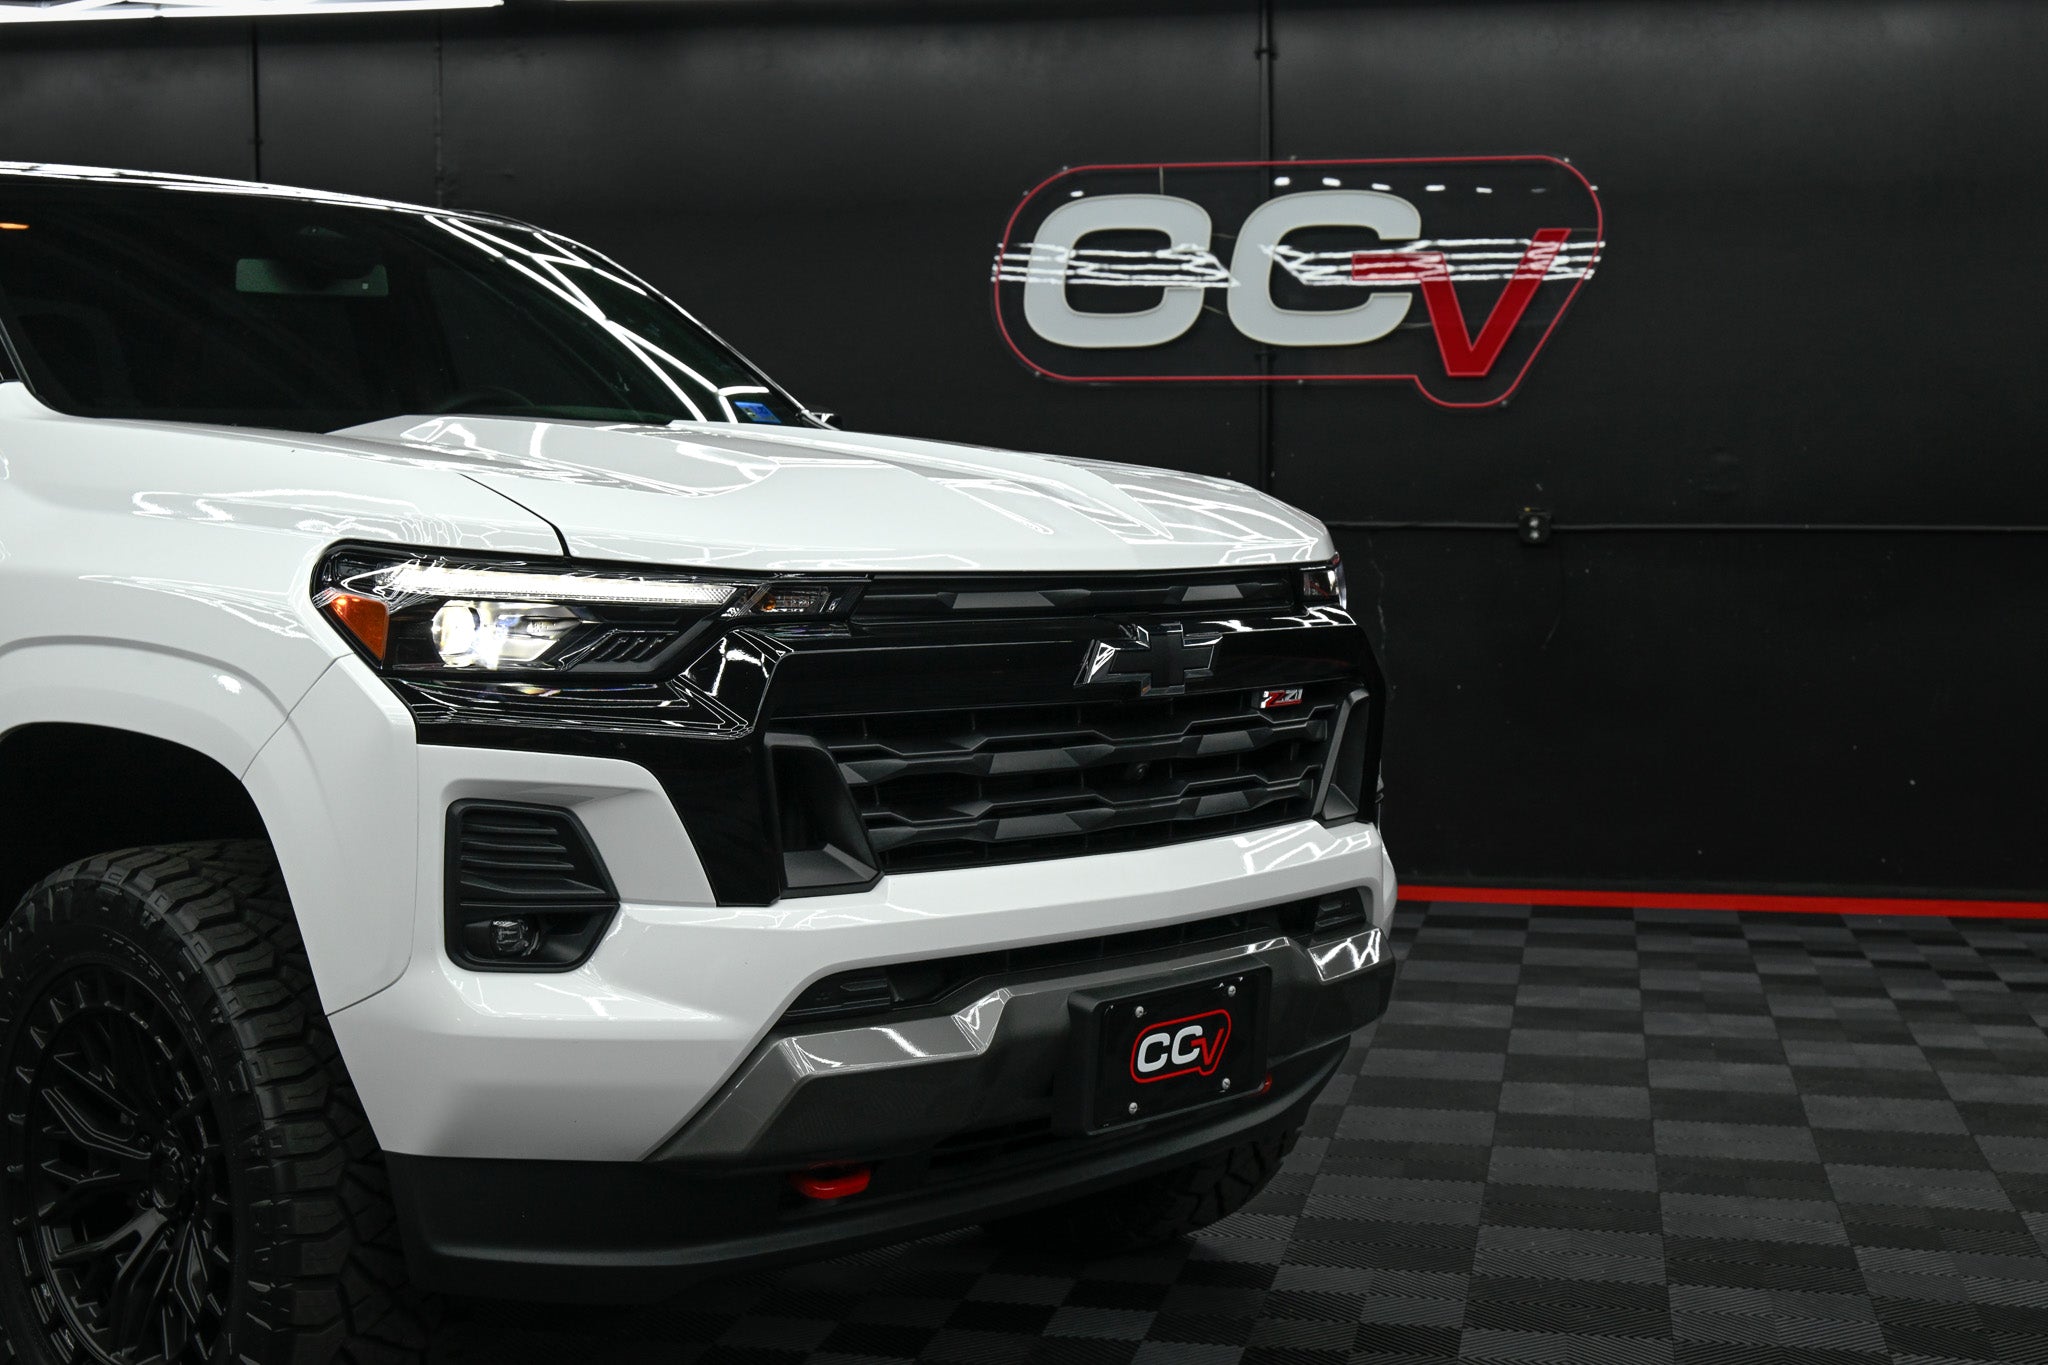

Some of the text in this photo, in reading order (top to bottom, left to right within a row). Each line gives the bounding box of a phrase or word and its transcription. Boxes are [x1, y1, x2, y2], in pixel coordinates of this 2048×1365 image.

[1024, 189, 1572, 377] CCV
[1260, 688, 1304, 709] Z71
[1137, 1025, 1225, 1073] CCV
